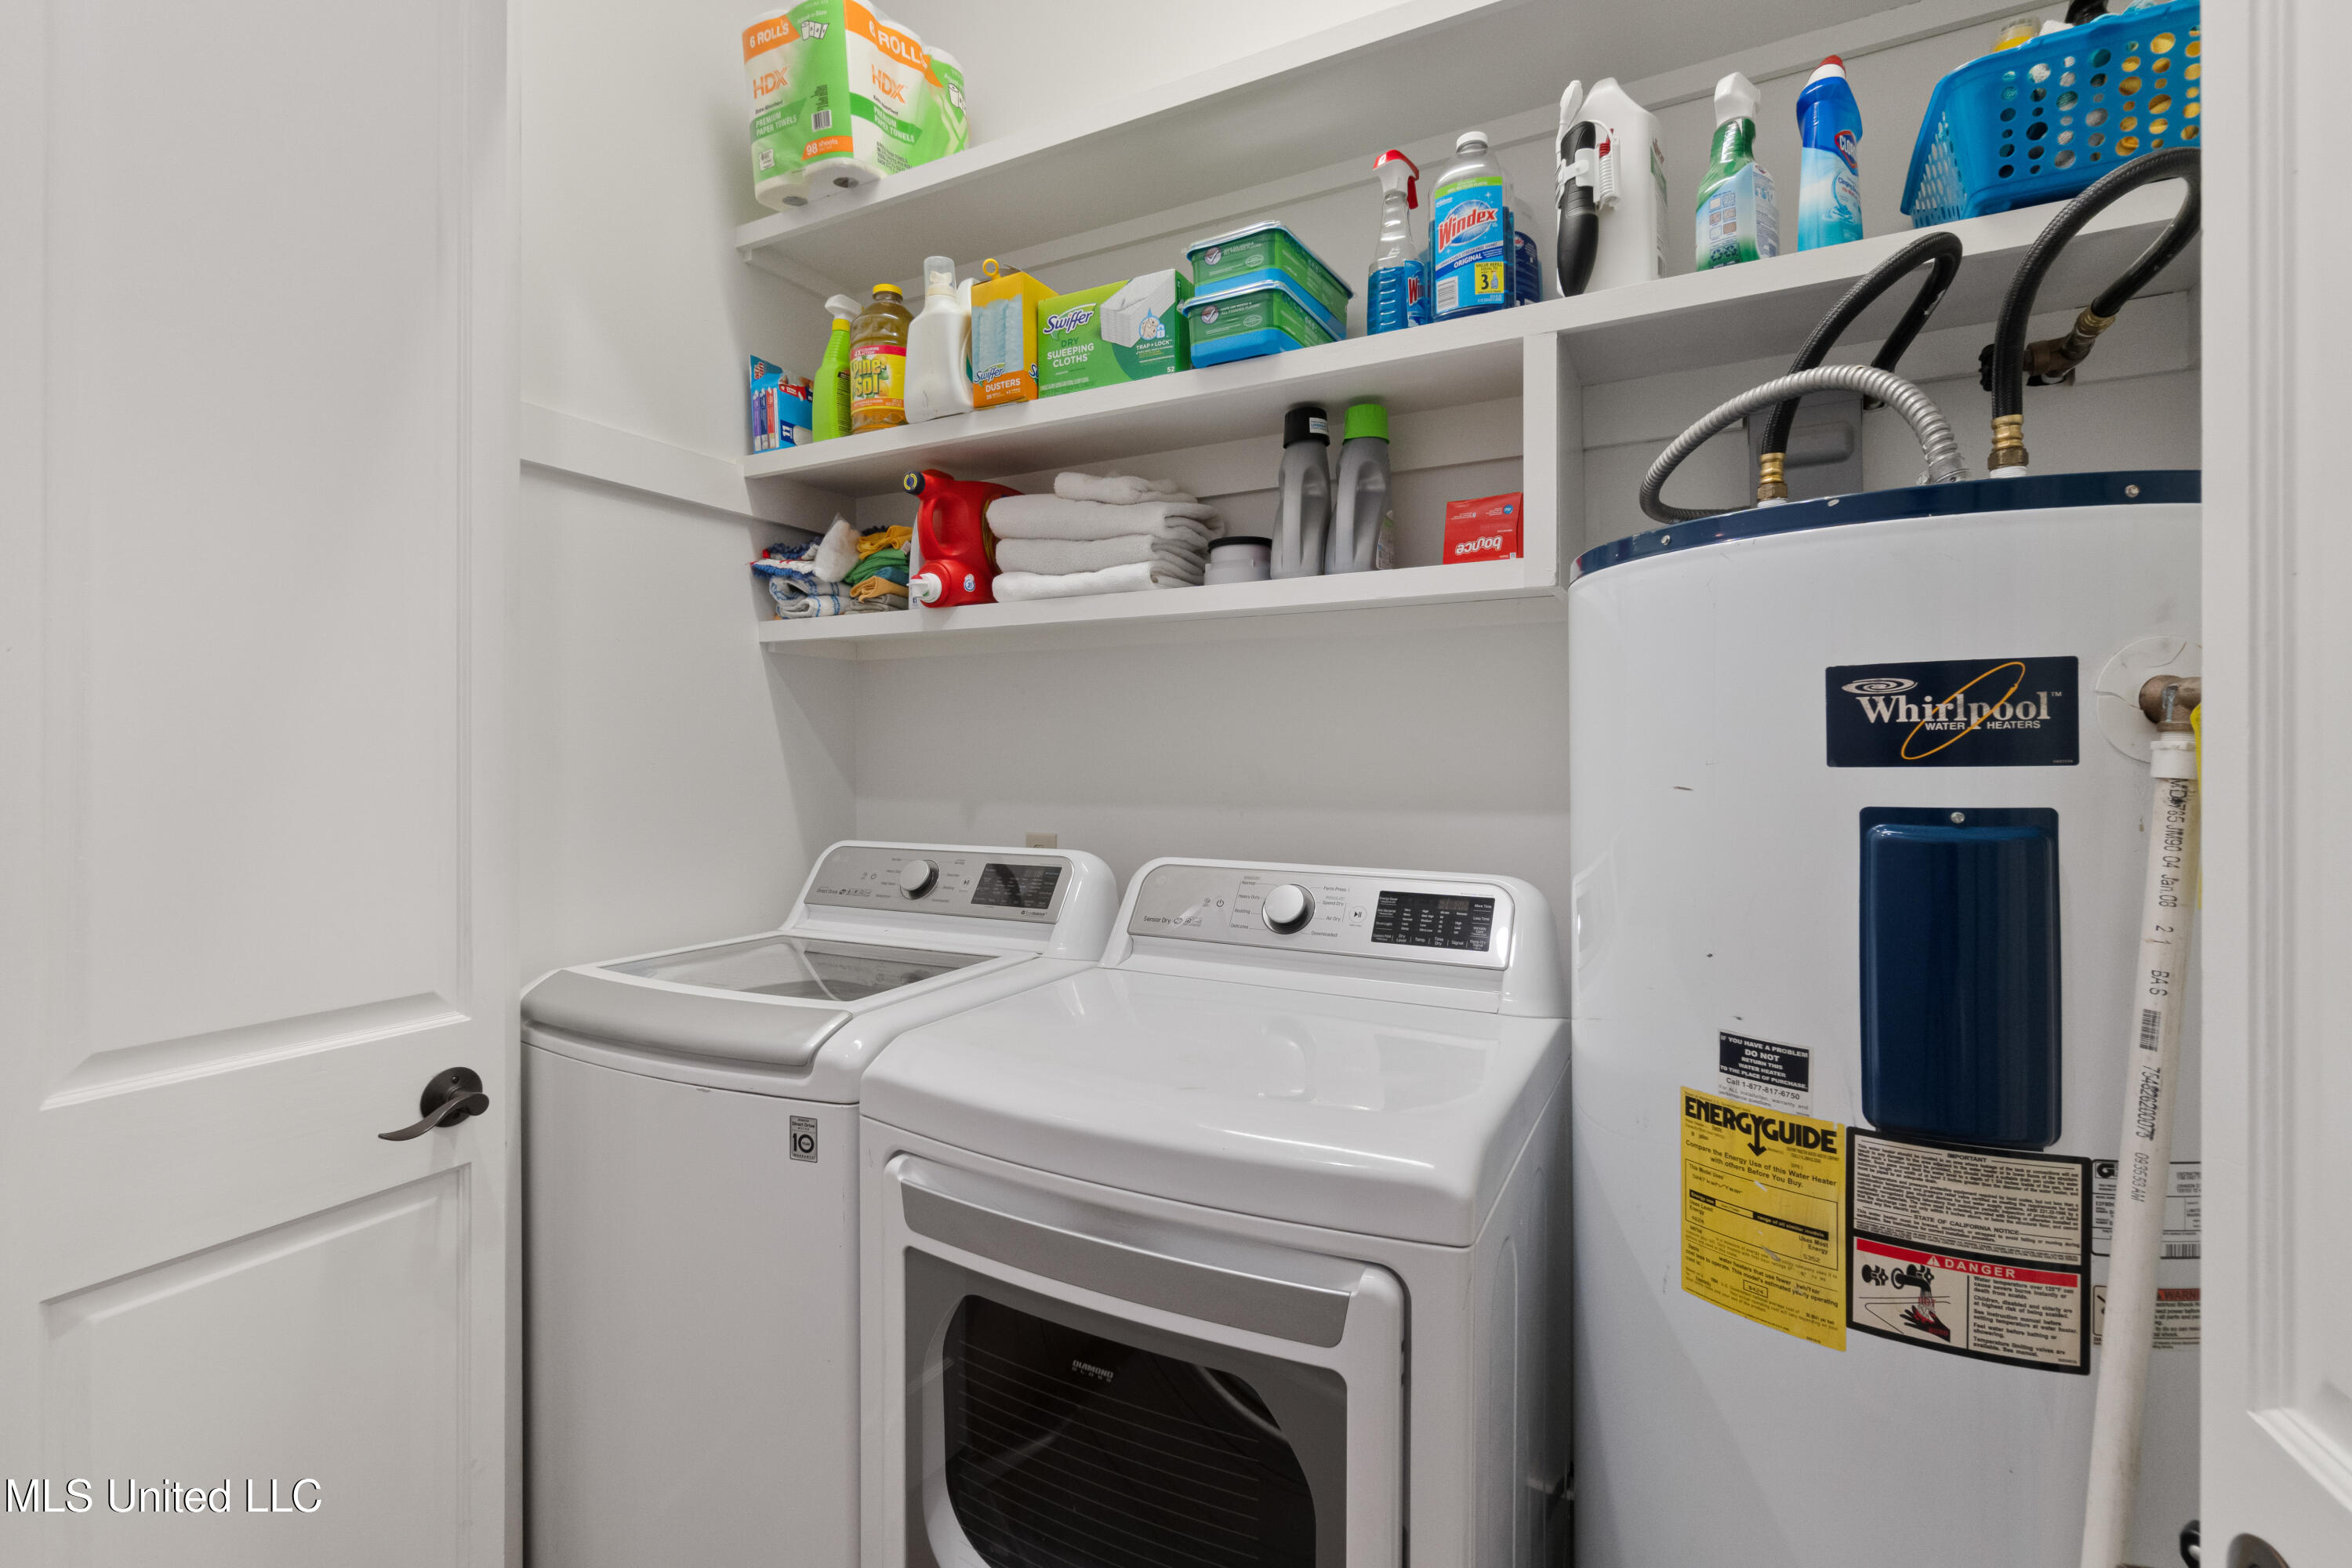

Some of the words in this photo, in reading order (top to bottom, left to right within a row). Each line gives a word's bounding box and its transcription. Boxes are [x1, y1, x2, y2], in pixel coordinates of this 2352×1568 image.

[750, 36, 756, 48] 6
[757, 23, 789, 45] ROLLS
[753, 67, 788, 99] HDX
[872, 64, 906, 103] HDX
[756, 111, 782, 127] PREMIUM
[756, 124, 775, 136] PAPER
[776, 114, 797, 128] TOWELS
[874, 106, 897, 127] PREMIUM
[874, 115, 889, 132] PAPER
[890, 128, 915, 143] TOWELS
[806, 143, 818, 156] 98
[1439, 209, 1497, 251] Windex
[1454, 252, 1483, 268] ORIGINAL
[1481, 274, 1489, 290] 3
[1044, 310, 1094, 333] Swiffer
[1061, 337, 1079, 347] DRY
[1047, 343, 1094, 360] SWEEPING
[974, 367, 1004, 383] Swiffer
[855, 374, 880, 397] Sol
[985, 378, 1021, 392] DUSTERS
[1456, 535, 1502, 555] bounce
[1856, 691, 2052, 730] Whirlpool
[1925, 722, 1965, 731] WATER
[1987, 720, 2041, 729] HEATERS
[1744, 1040, 1764, 1049] HAVE
[1772, 1047, 1808, 1058] PROBLEM
[1760, 1052, 1780, 1062] NOT
[1741, 1057, 1767, 1066] RETURN
[1738, 1063, 1759, 1072] WATER
[1761, 1069, 1787, 1078] HEATER
[1742, 1080, 1800, 1100] 1-877-817-6750
[1771, 1077, 1807, 1089] PURCHASE.
[1685, 1095, 1838, 1155] ENERGYGUIDE
[793, 1133, 815, 1153] 10
[1686, 1139, 1711, 1152] Compare
[1725, 1152, 1747, 1165] Energy
[1749, 1160, 1762, 1168] Use
[1788, 1170, 1809, 1180] Water
[1813, 1175, 1837, 1186] Heater
[1947, 1153, 1987, 1163] IMPORTANT
[1725, 1161, 1745, 1172] others
[1748, 1167, 1769, 1178] Before
[1773, 1174, 1785, 1182] You
[1788, 1178, 1802, 1188] Buy.
[1914, 1214, 1935, 1223] STATE
[1950, 1221, 1992, 1232] CALIFORNIA
[1808, 1244, 1828, 1255] Energy
[1944, 1258, 2016, 1279] DANGER
[1732, 1267, 1742, 1276] This
[1811, 1295, 1838, 1308] operating
[1776, 1276, 1791, 1285] fewer
[1993, 1279, 2027, 1289] temperature
[2002, 1299, 2027, 1308] disabled
[1995, 1318, 2030, 1327] temperature
[1973, 1336, 2009, 1347] Temperature
[2012, 1342, 2034, 1351] limiting
[2027, 1331, 2049, 1340] bathing
[1073, 1359, 1113, 1378] DIAMOND
